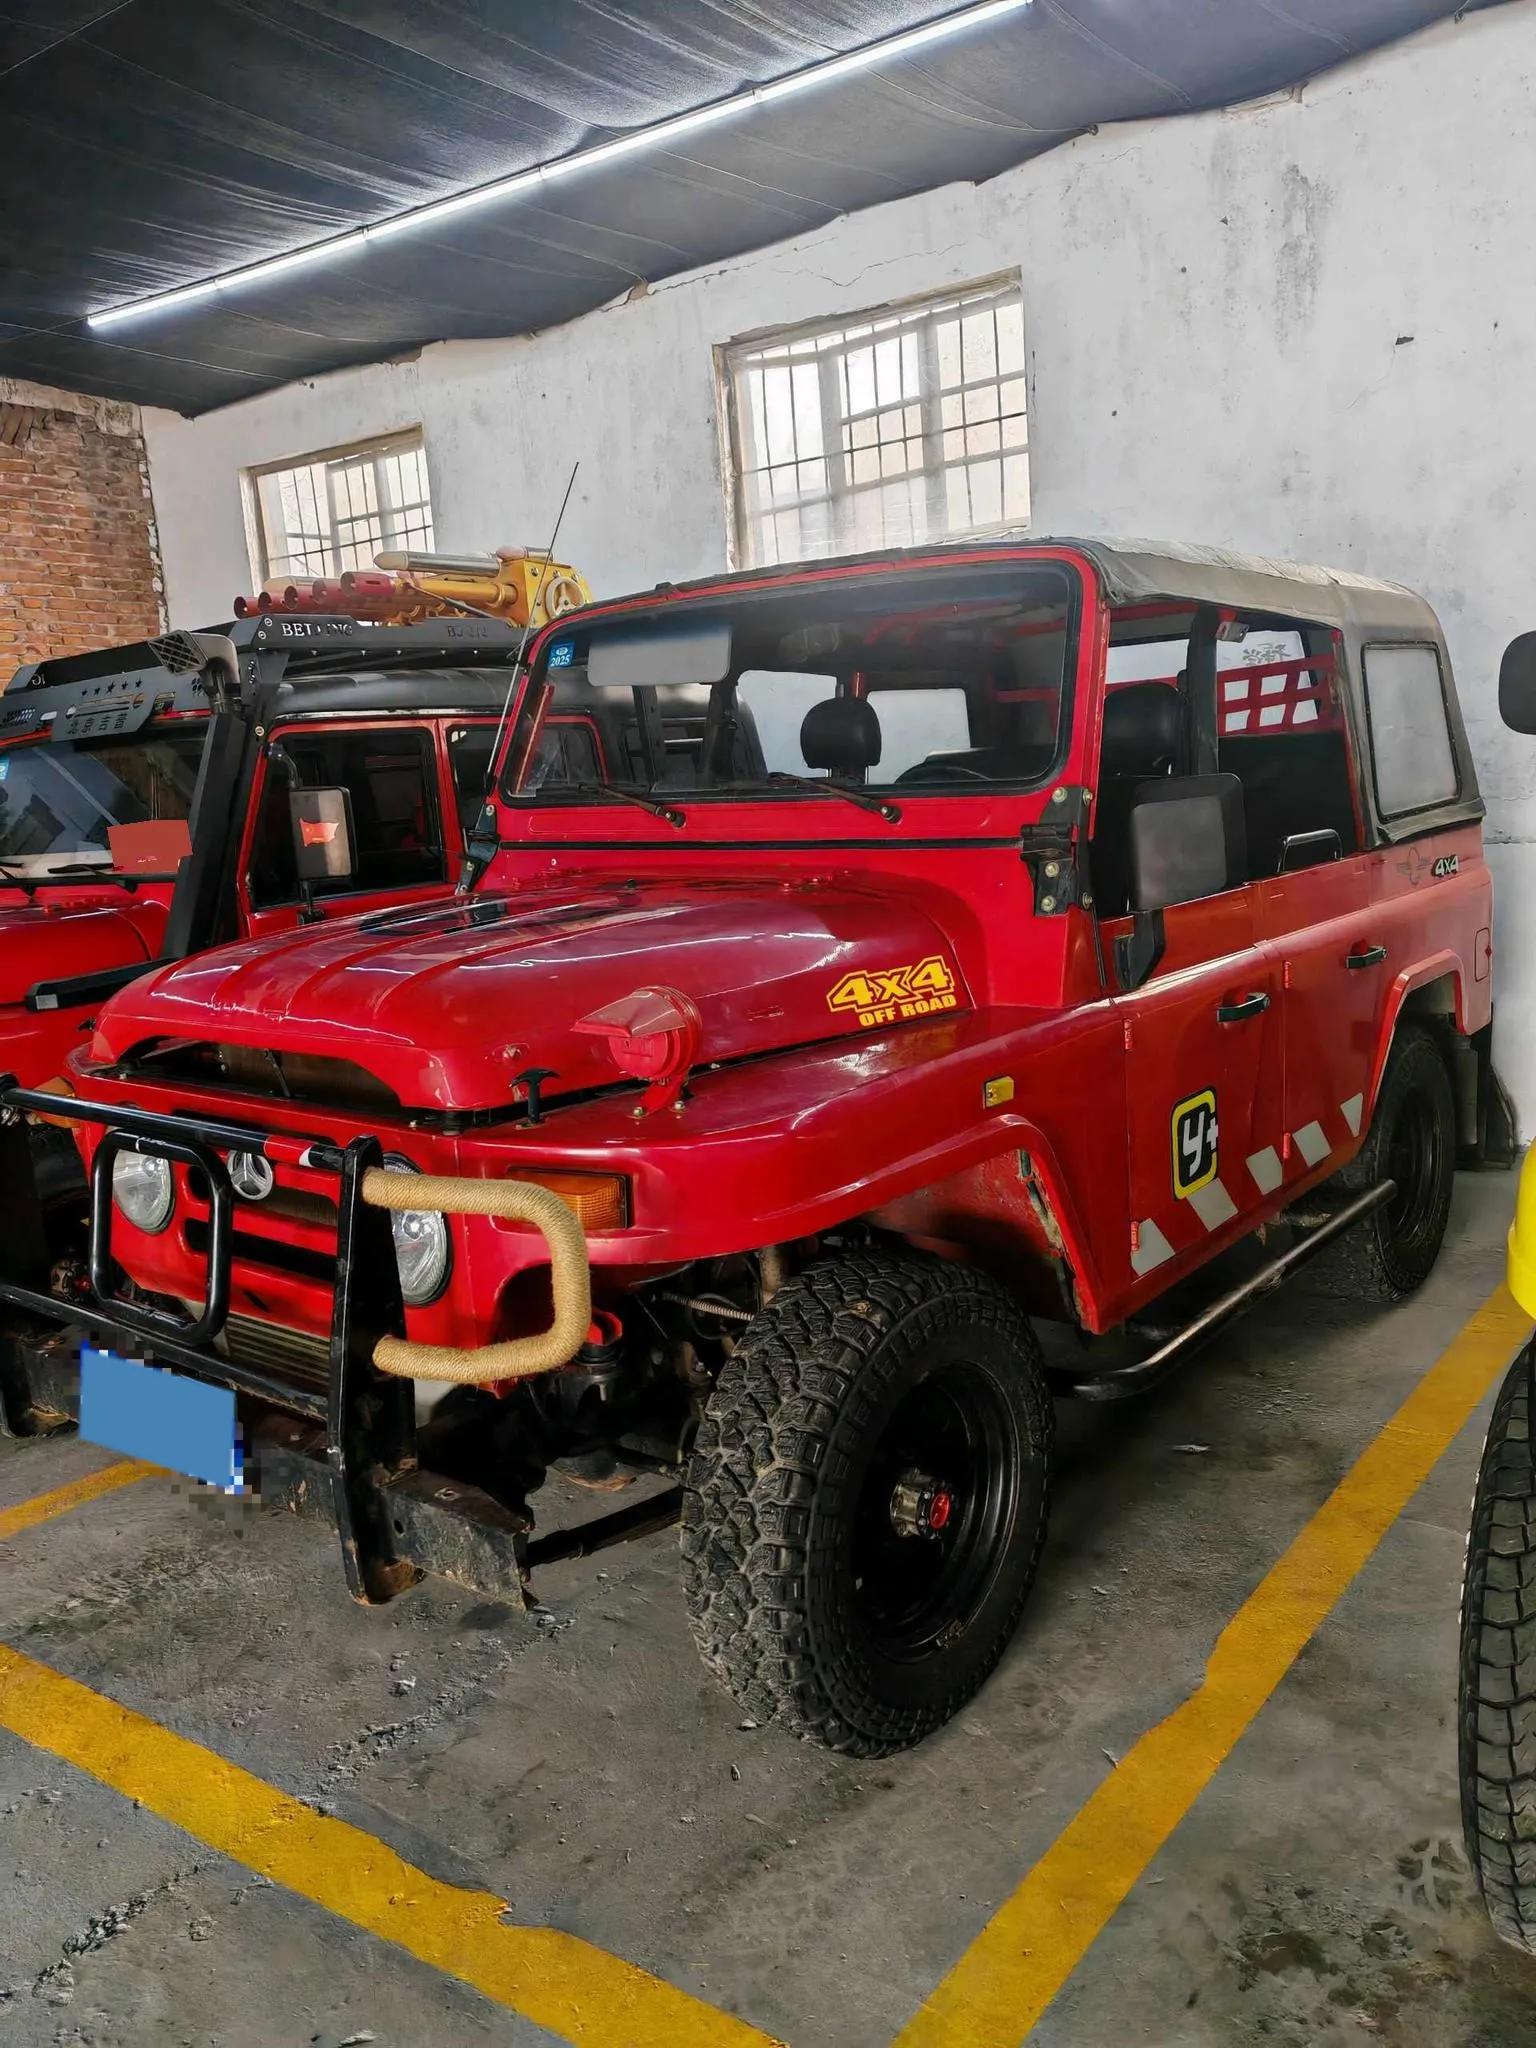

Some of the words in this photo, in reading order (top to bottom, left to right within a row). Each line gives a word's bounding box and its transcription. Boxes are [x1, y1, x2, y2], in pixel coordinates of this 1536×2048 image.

[550, 654, 571, 667] 2025
[858, 1007, 897, 1027] OFF
[900, 994, 957, 1018] ROAD
